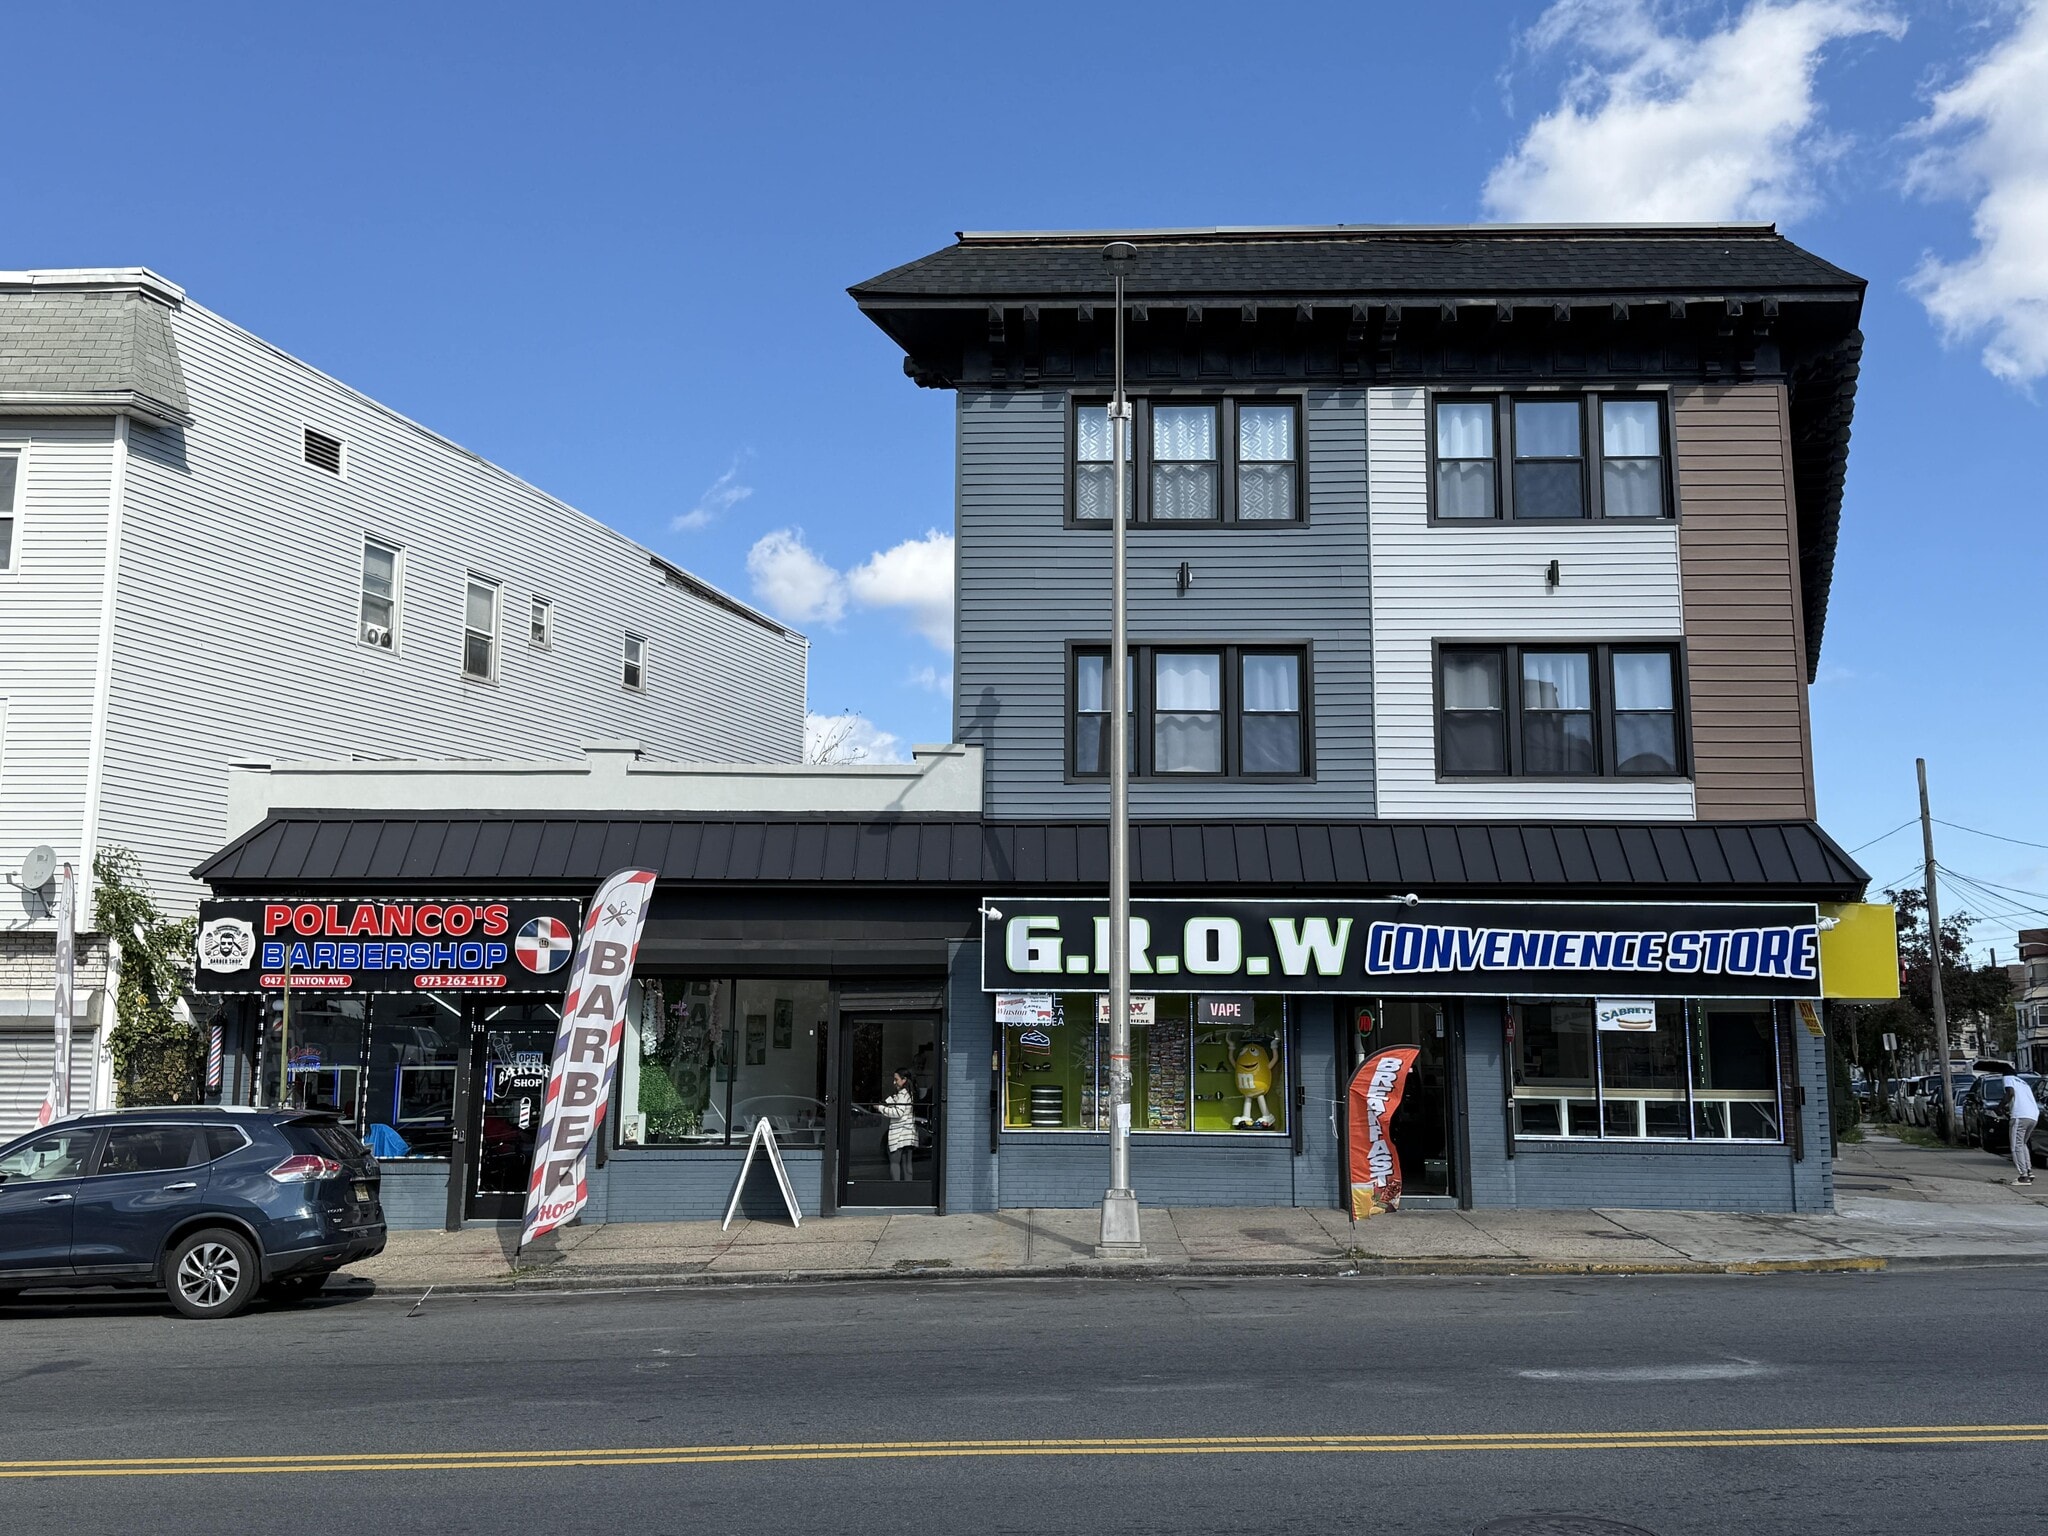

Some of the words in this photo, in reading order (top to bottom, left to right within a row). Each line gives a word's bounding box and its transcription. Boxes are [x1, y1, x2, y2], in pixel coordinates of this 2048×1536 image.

[264, 904, 509, 937] POLANCO'S
[261, 942, 508, 970] BARBERSHOP
[1365, 921, 1667, 975] CONVENIENCE
[1665, 925, 1819, 980] STORE
[264, 976, 282, 985] 947
[283, 976, 325, 985] LINTON
[327, 976, 348, 985] AVE.
[421, 976, 500, 986] 973-262-4157
[998, 1008, 1027, 1016] Winston
[1210, 1003, 1241, 1017] VAPE
[1601, 1007, 1653, 1022] SABRETT
[519, 1053, 541, 1063] OPEN
[499, 1064, 551, 1086] BARBE
[544, 940, 627, 1197] BARBER
[513, 1079, 542, 1087] SHOP
[1367, 1057, 1403, 1188] BREAKFAST
